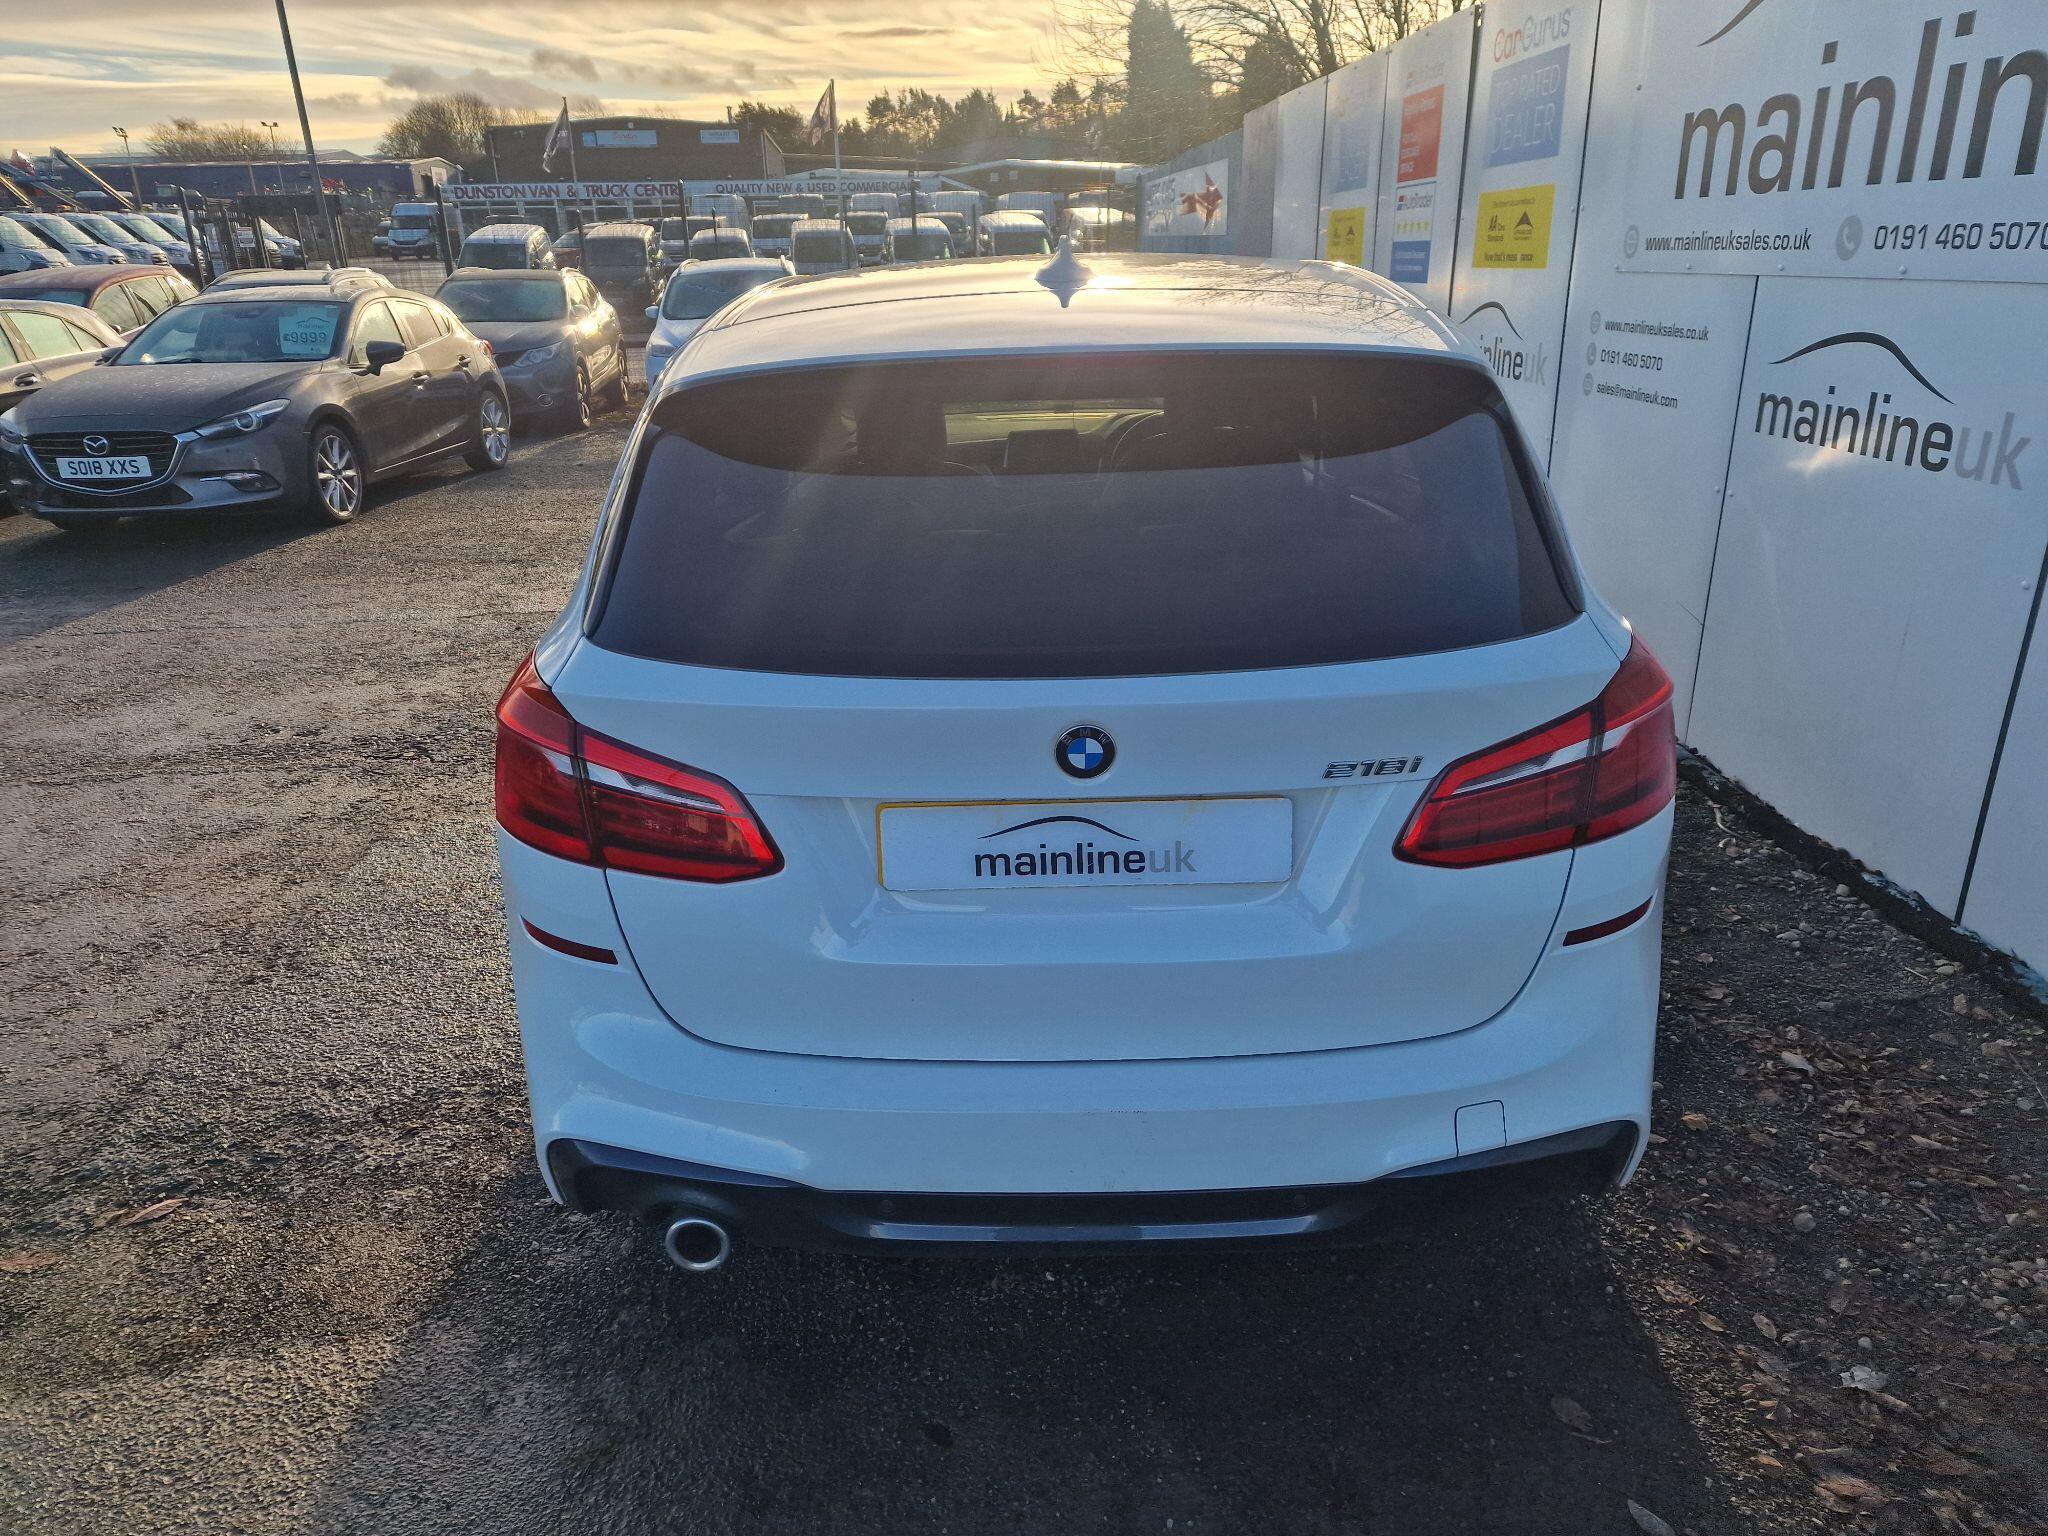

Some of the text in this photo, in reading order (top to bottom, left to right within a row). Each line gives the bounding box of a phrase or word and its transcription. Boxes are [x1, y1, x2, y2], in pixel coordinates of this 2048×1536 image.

[1493, 8, 1571, 63] CarGurus
[1519, 64, 1561, 100] RATED
[1674, 9, 2048, 200] mainlin
[1490, 103, 1556, 154] DEALER
[454, 183, 680, 200] DUNSTON VAN & TRUCK CENTR
[715, 182, 762, 194] QUALITY
[766, 182, 792, 193] NEW
[796, 182, 803, 193] &
[807, 182, 836, 193] USED
[1645, 227, 1812, 251] www.mainlineuksales.co.uk
[1873, 224, 1930, 251] 0191
[1935, 223, 1984, 250] 460
[1604, 319, 1710, 341] www.mainlineuksales.co.uk
[1479, 334, 1548, 387] nlineuk
[1600, 349, 1663, 371] 0191 460 5070
[1596, 381, 1679, 409] sales@mainlineuk.com
[1754, 385, 2032, 490] mainlineuk
[106, 459, 140, 475] XXS
[1322, 755, 1425, 779] 218i
[974, 840, 1198, 877] mainlineuk
